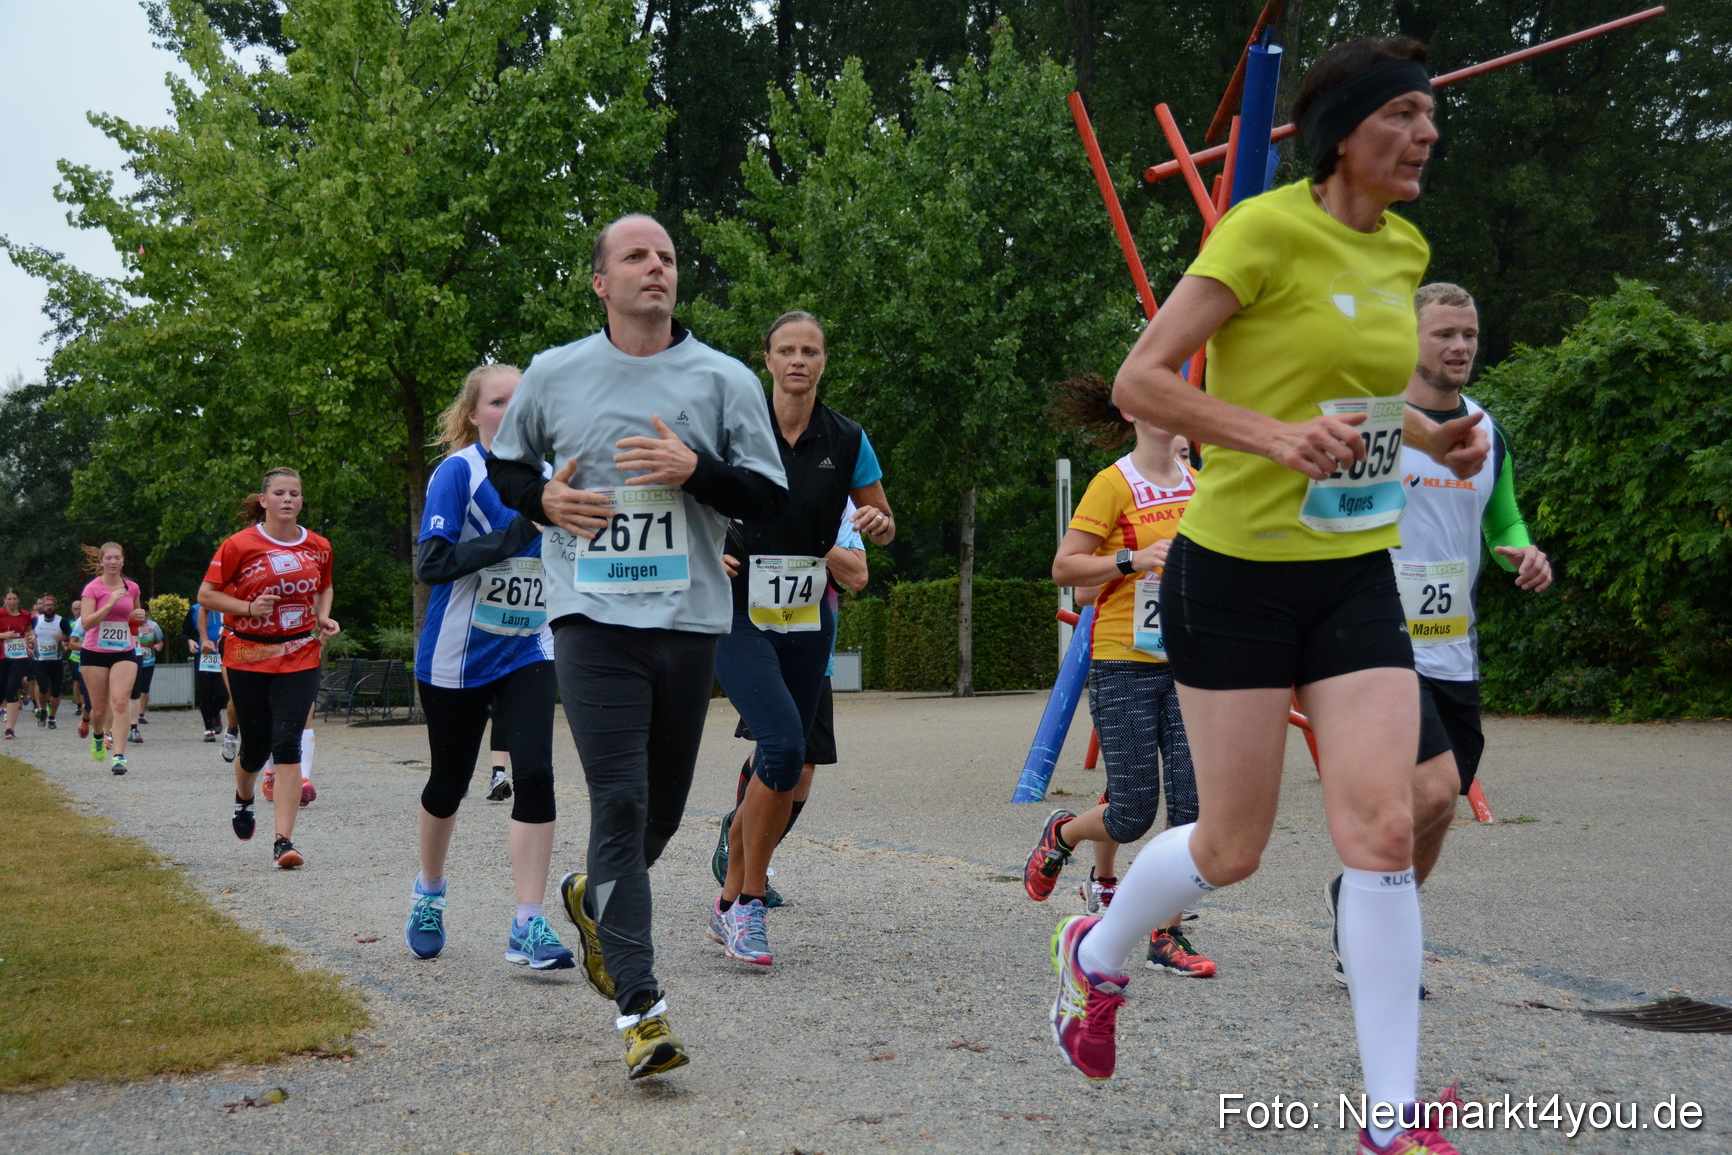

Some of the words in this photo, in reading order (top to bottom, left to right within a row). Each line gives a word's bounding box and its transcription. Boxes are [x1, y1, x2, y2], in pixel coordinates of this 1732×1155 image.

[1423, 478, 1477, 491] KLEBL
[623, 489, 676, 503] BOCK
[1339, 493, 1373, 516] Agnes
[1139, 509, 1175, 524] MAX
[588, 511, 673, 552] 2671
[608, 563, 658, 581] Jürgen
[1429, 564, 1466, 576] BOCK
[487, 577, 544, 606] 2672
[768, 576, 812, 604] 174
[1419, 583, 1451, 614] 25
[502, 613, 530, 626] Laura
[102, 629, 128, 640] 2201
[1412, 623, 1451, 635] Markus
[7, 643, 25, 651] 2035
